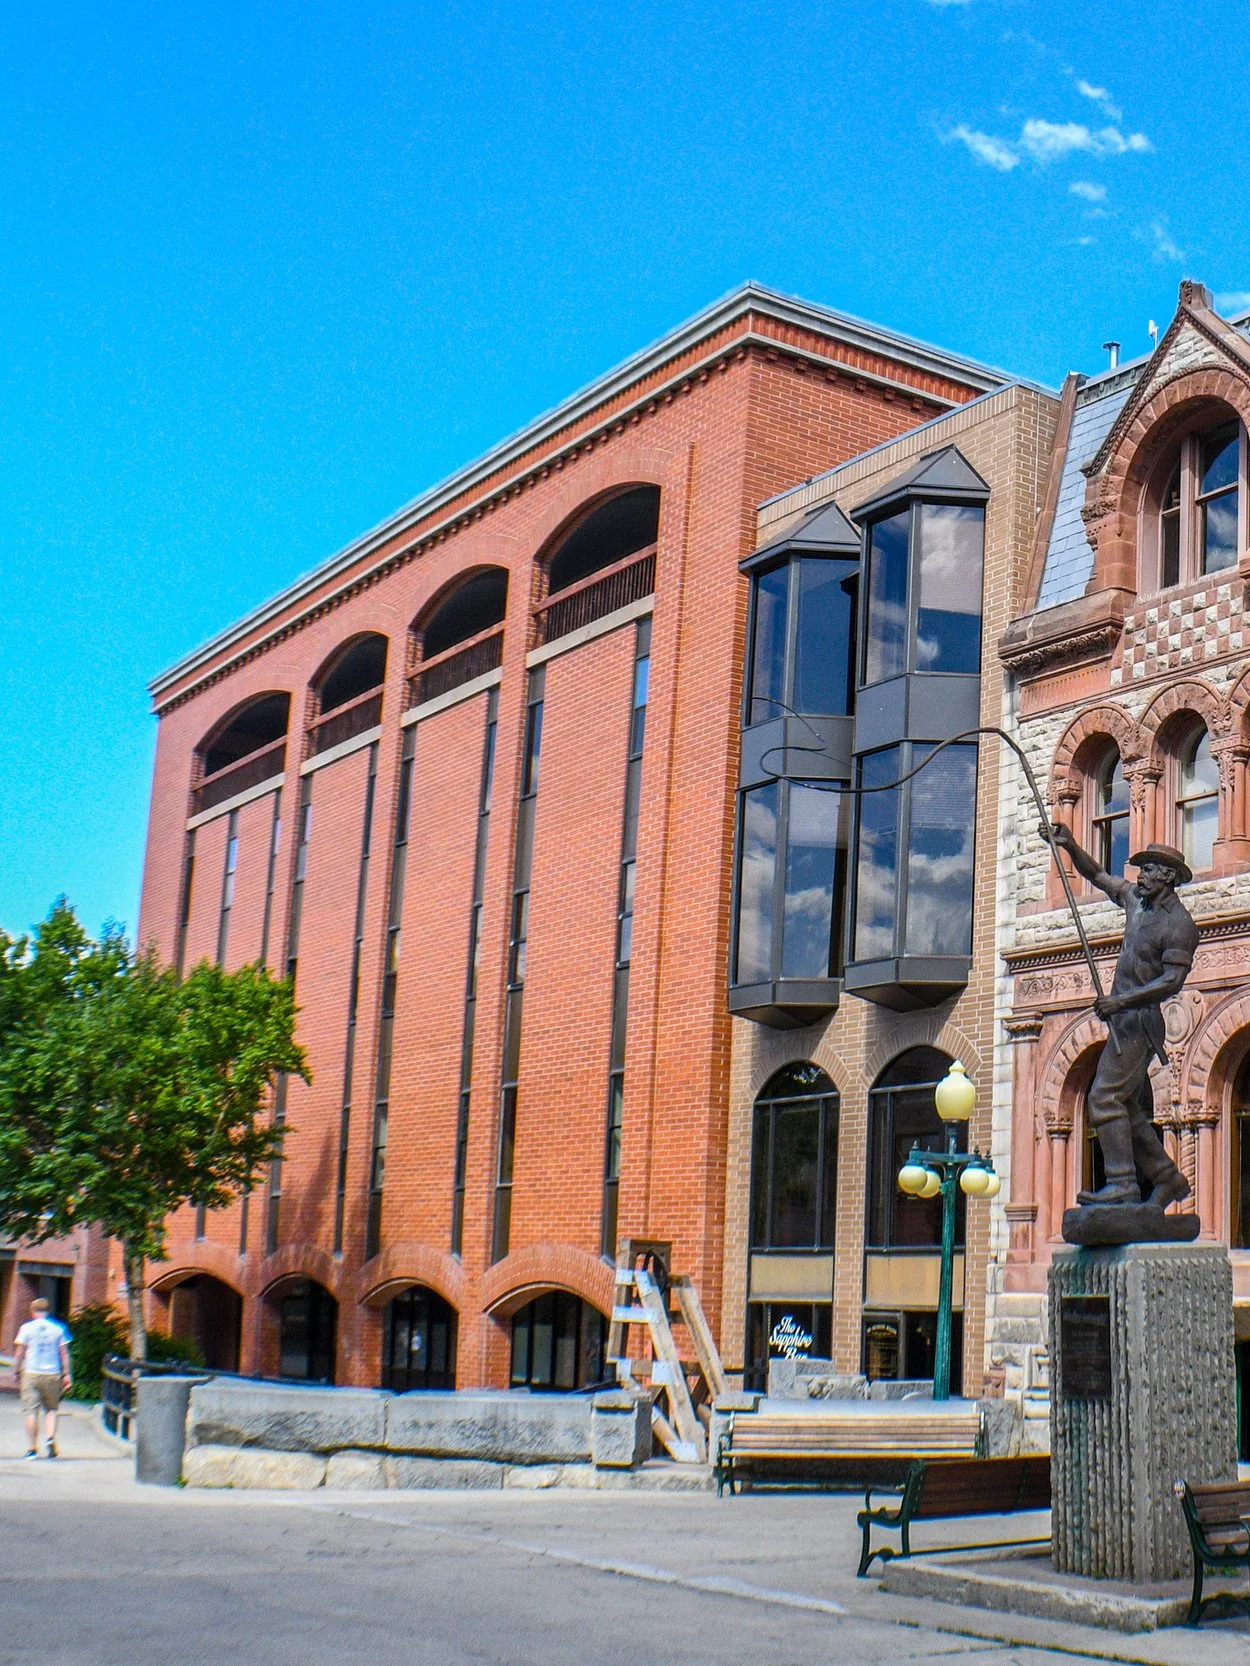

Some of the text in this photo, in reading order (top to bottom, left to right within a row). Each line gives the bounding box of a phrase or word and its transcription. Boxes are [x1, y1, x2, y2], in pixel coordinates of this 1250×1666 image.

[779, 1314, 796, 1334] The
[769, 1325, 813, 1353] Sapphire
[784, 1346, 808, 1360] Bar
